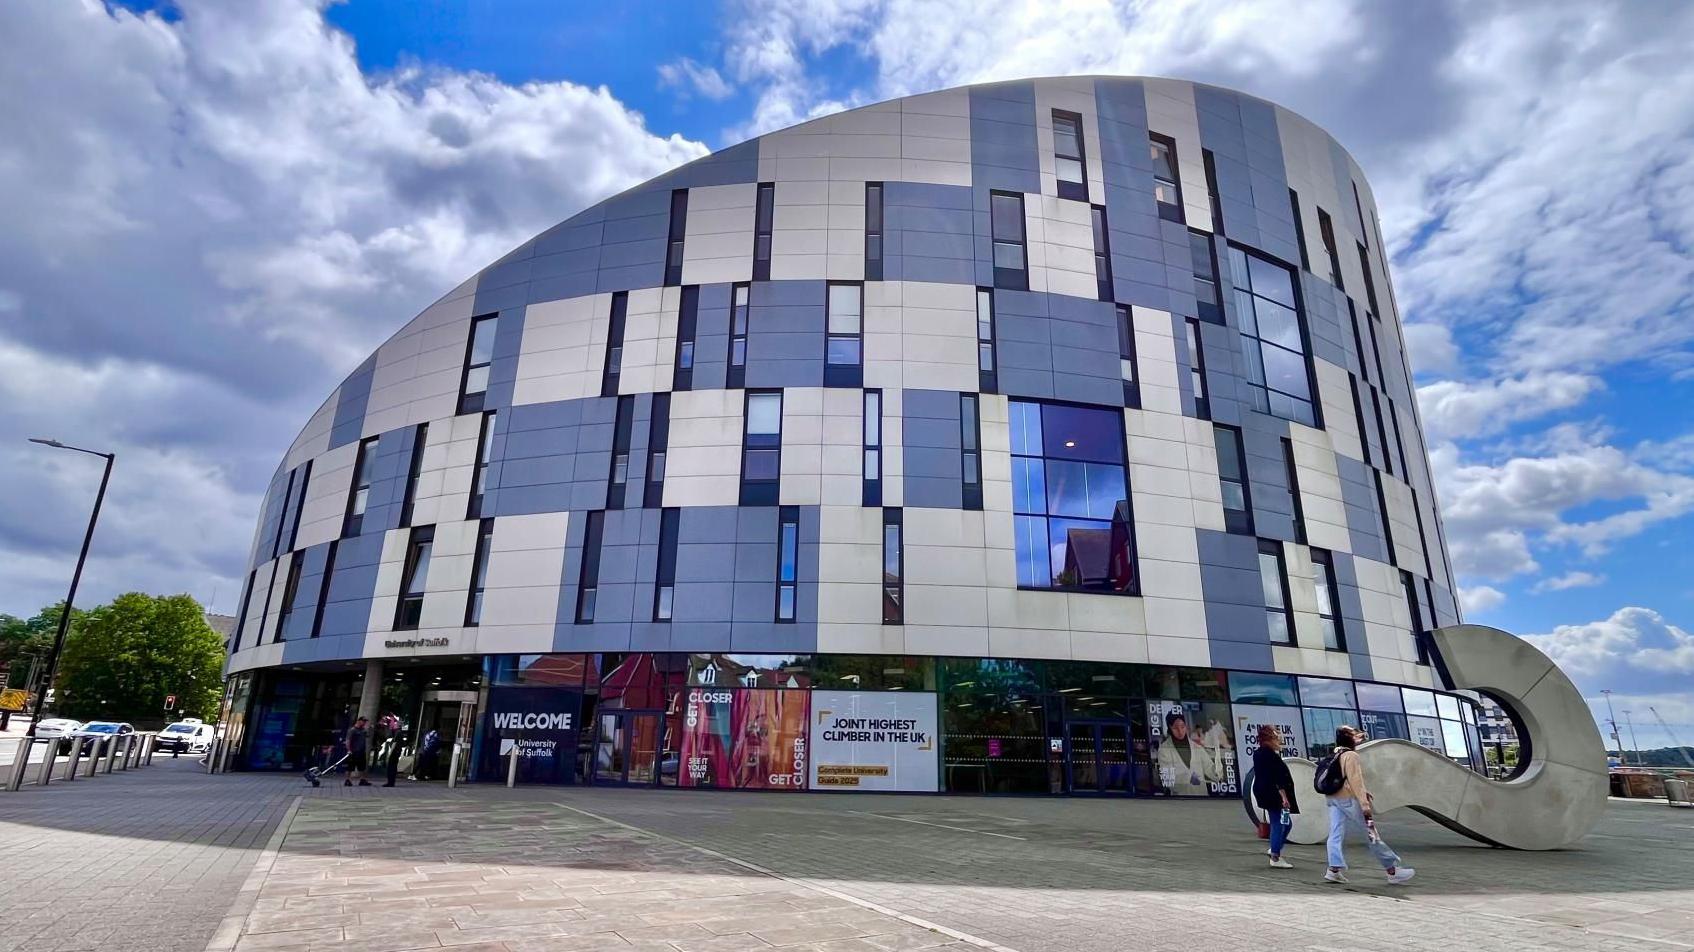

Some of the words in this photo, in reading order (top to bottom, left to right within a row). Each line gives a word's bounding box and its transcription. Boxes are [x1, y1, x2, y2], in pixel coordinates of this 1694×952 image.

[689, 692, 733, 704] CLOSER
[687, 703, 698, 727] GET
[1149, 703, 1183, 715] DEER
[494, 712, 571, 730] WELCOME
[832, 718, 867, 730] JOINT
[868, 719, 916, 731] HIGHEST
[1150, 715, 1161, 736] DIG
[1281, 724, 1293, 735] UK
[823, 731, 871, 742] CLIMBER
[873, 731, 885, 742] IN
[886, 732, 908, 743] THE
[909, 732, 926, 743] UK
[518, 739, 557, 750] University
[518, 748, 526, 756] of
[526, 748, 553, 757] Suffolk
[793, 737, 805, 786] CLOSER
[688, 764, 707, 772] YOUR
[853, 767, 888, 776] University
[1224, 751, 1237, 793] DEEPER
[689, 771, 706, 779] WAY
[768, 773, 793, 785] GET
[1211, 782, 1228, 793] DIG
